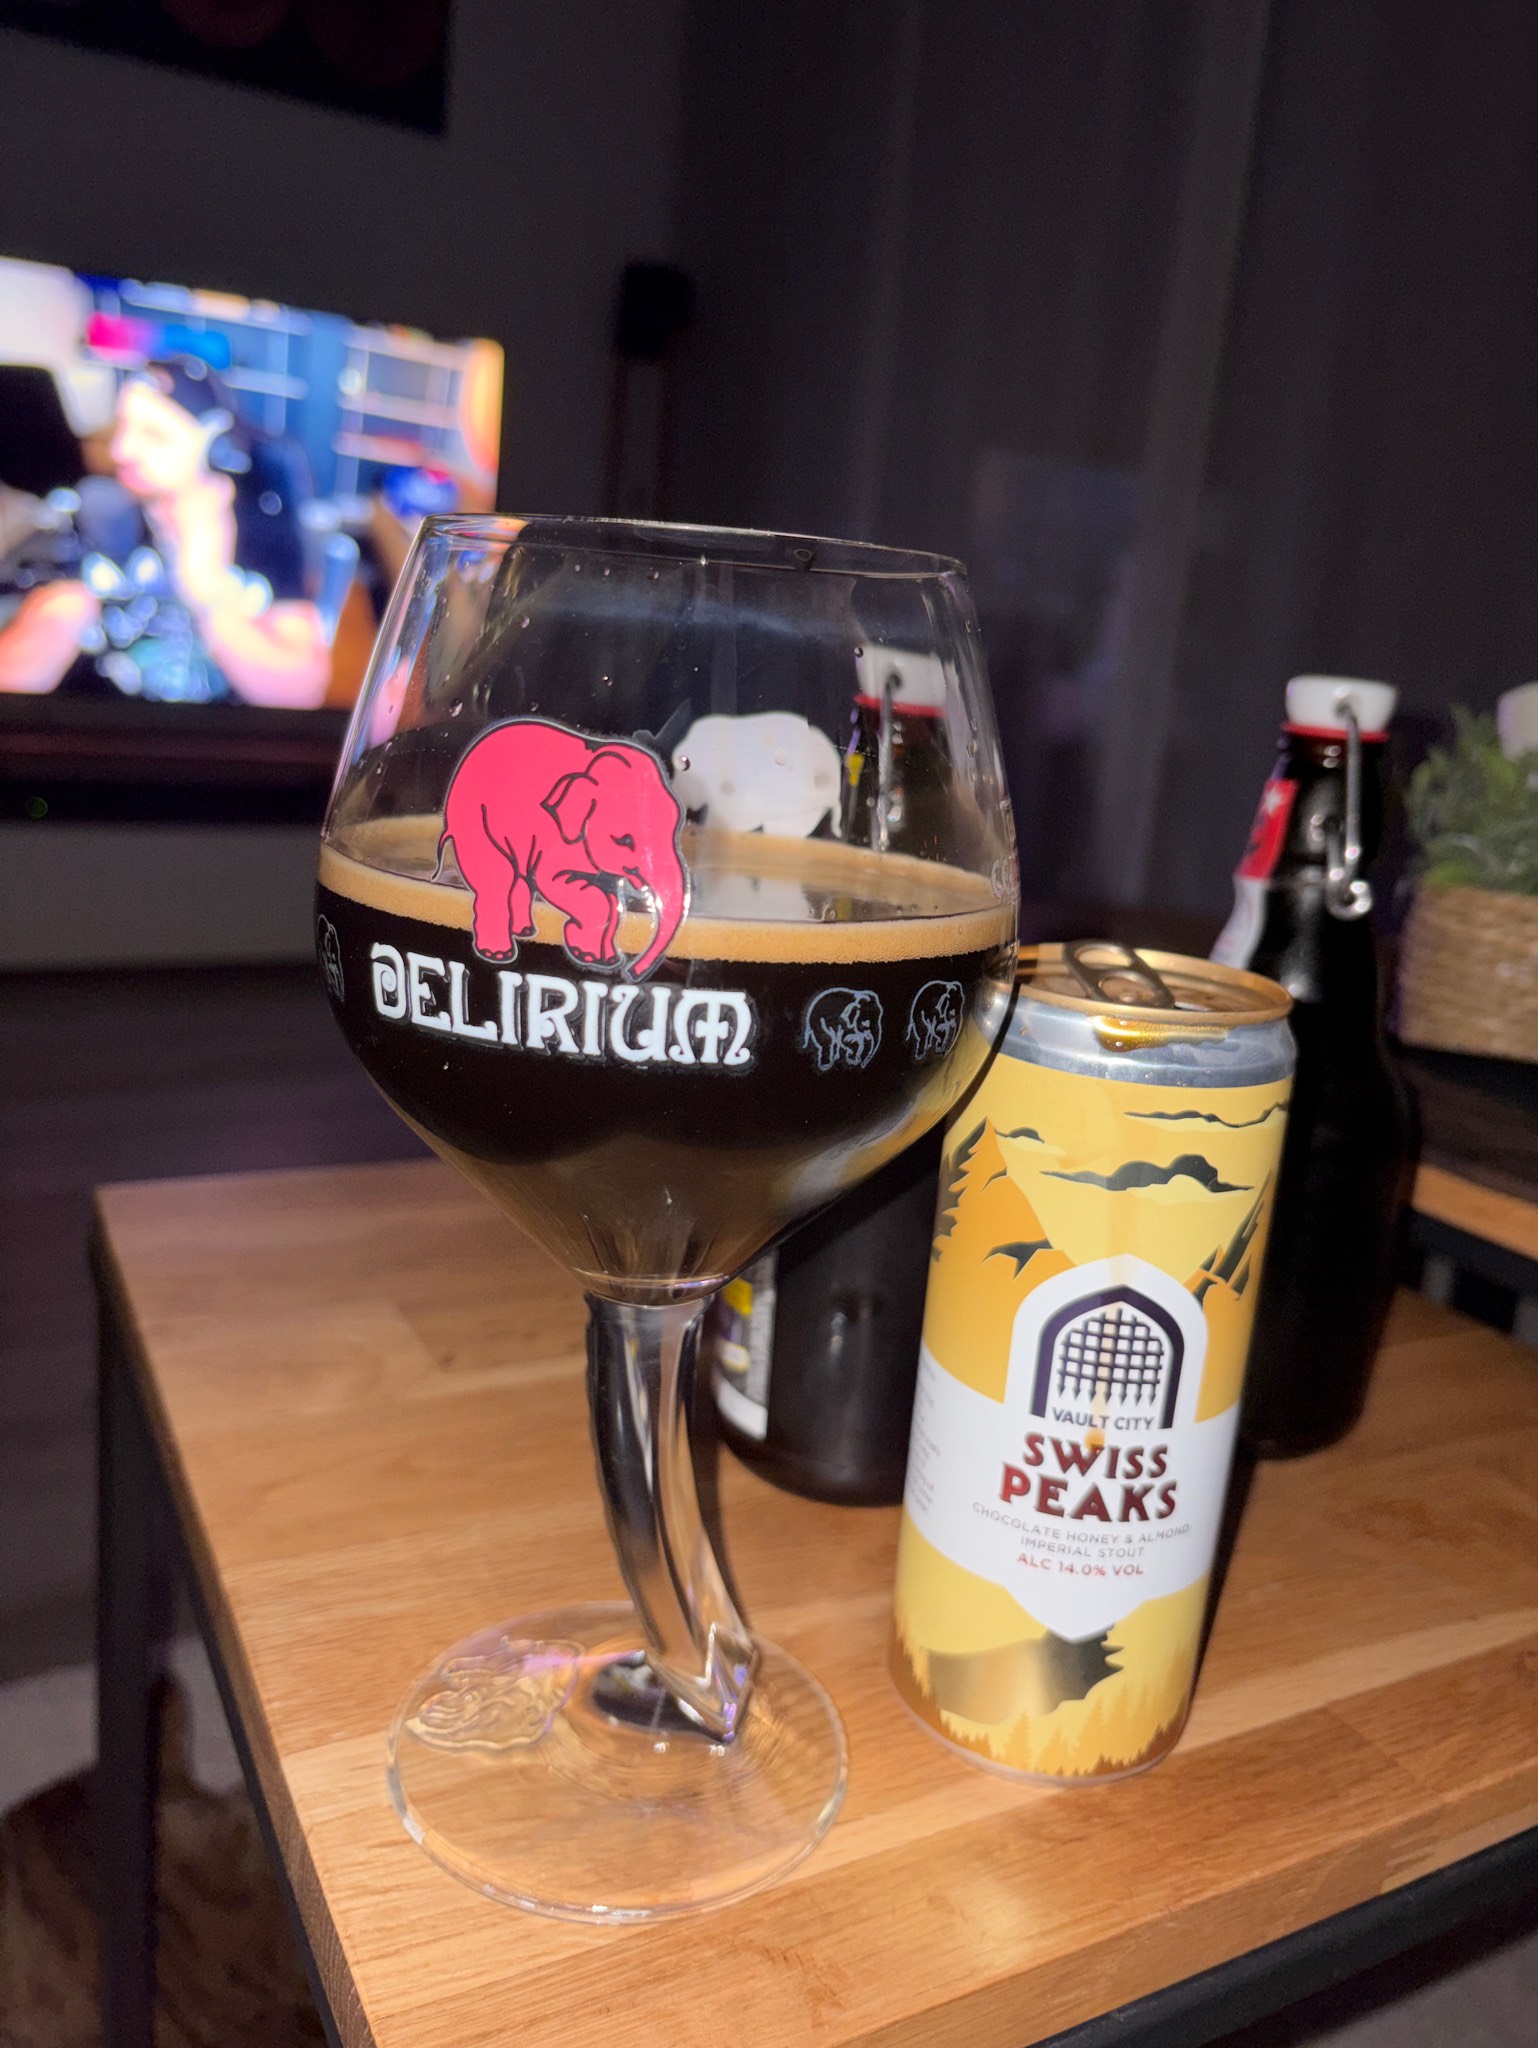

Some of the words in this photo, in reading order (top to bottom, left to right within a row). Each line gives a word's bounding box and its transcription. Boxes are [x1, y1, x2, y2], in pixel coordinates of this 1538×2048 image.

[371, 942, 753, 1066] DELIRIUM
[1052, 1406, 1109, 1429] VAULT
[1114, 1416, 1154, 1430] CITY
[1023, 1431, 1168, 1479] SWISS
[999, 1461, 1177, 1522] PEAKS
[972, 1502, 1060, 1539] CHOCOLATE
[1066, 1531, 1119, 1544] HONEY
[1124, 1535, 1133, 1544] &
[1138, 1524, 1190, 1543] ALMOND
[1017, 1552, 1052, 1570] ALC
[1058, 1561, 1106, 1576] 14.0%
[1112, 1563, 1144, 1576] VOL
[1020, 1536, 1091, 1557] IMPERIAL
[1099, 1546, 1144, 1558] STOUT
